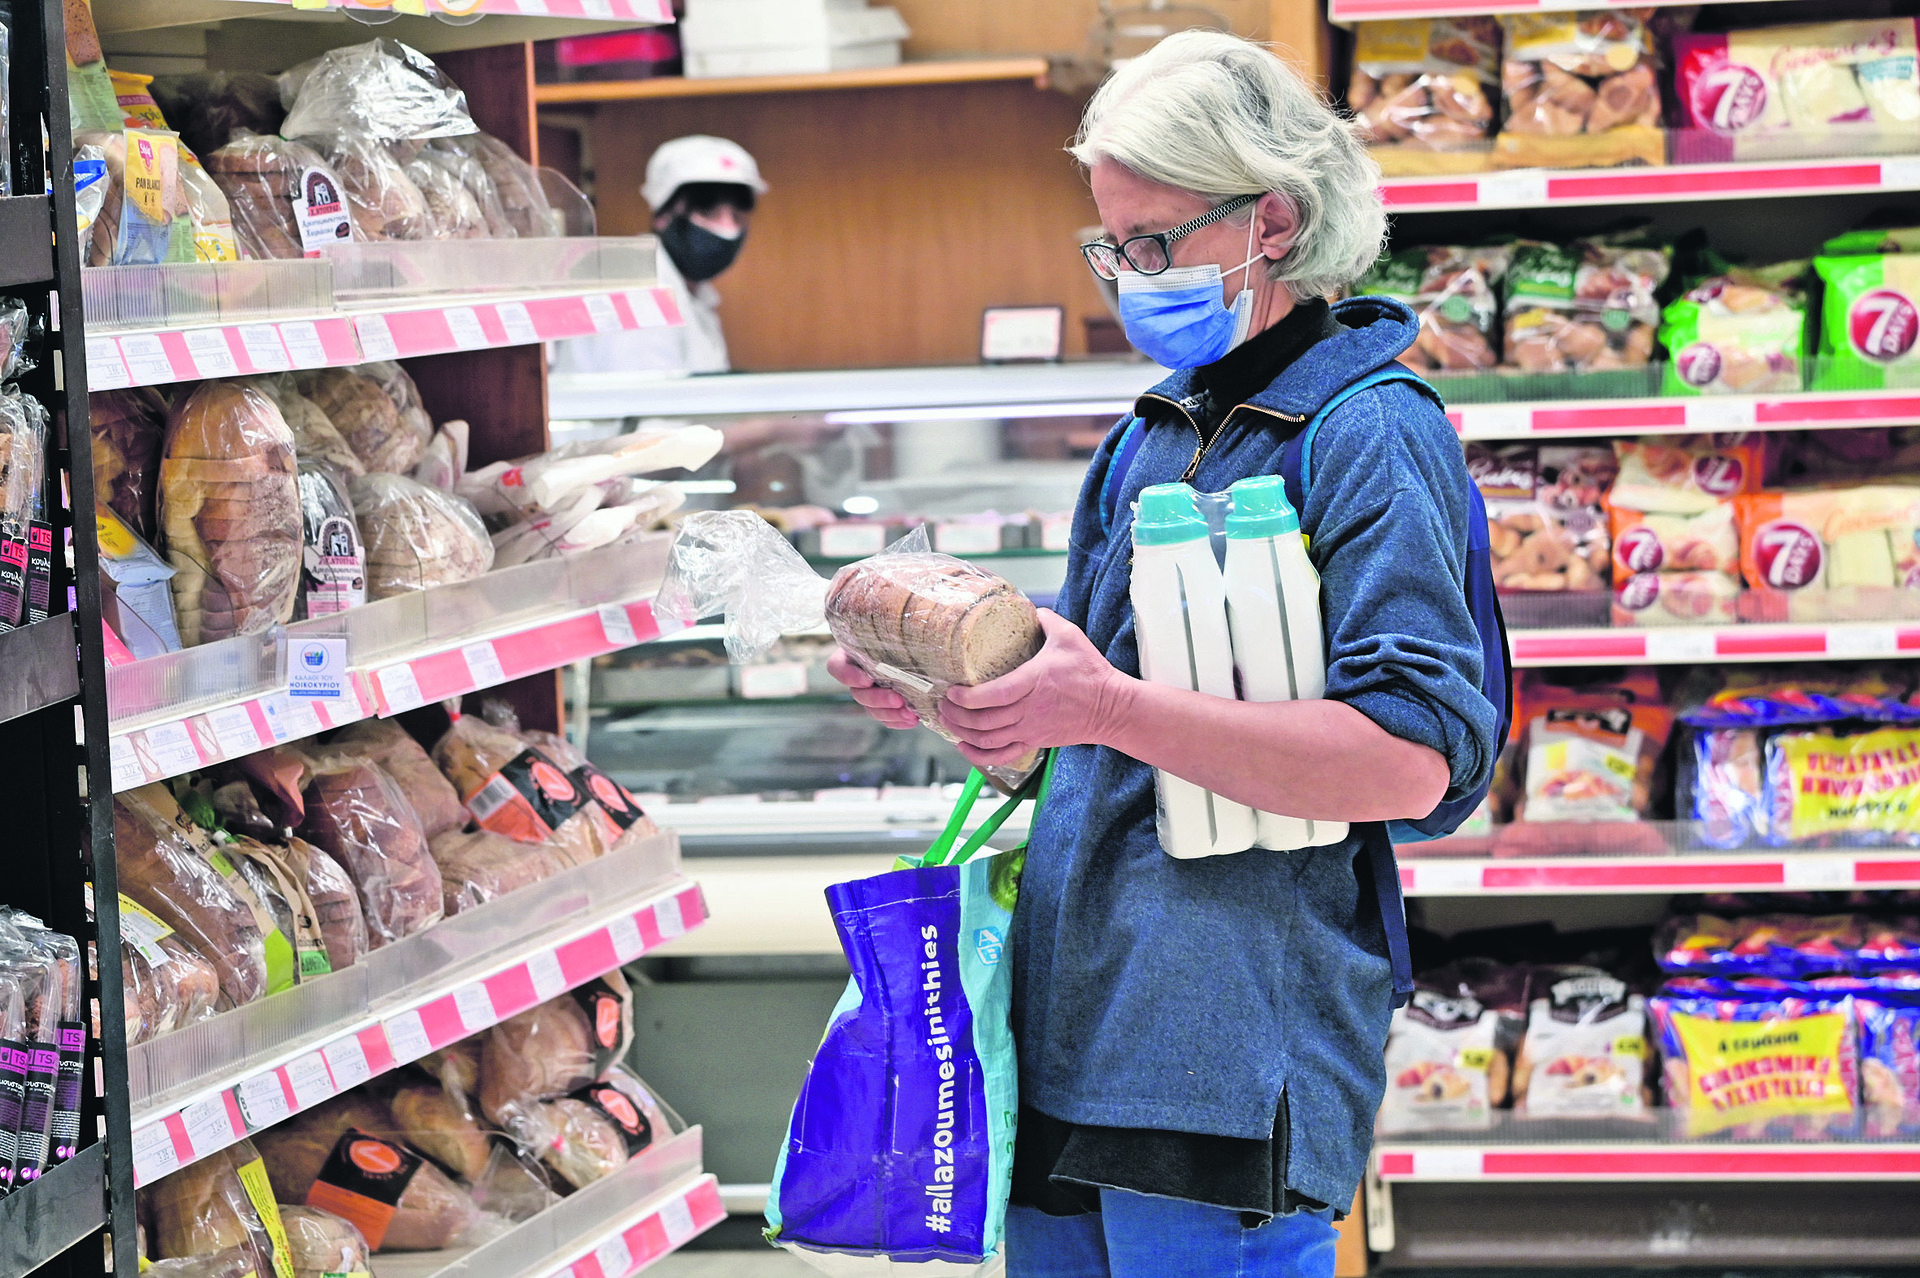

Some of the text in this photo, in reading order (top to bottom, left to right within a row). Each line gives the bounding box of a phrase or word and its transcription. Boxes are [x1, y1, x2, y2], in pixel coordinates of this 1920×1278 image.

[1706, 71, 1745, 129] 7
[135, 177, 146, 189] PAN
[1860, 297, 1915, 356] 7 DAYS
[1622, 534, 1652, 572] 7
[1762, 530, 1815, 586] 7 DAYS
[921, 924, 954, 1233] #allazoumesinithies
